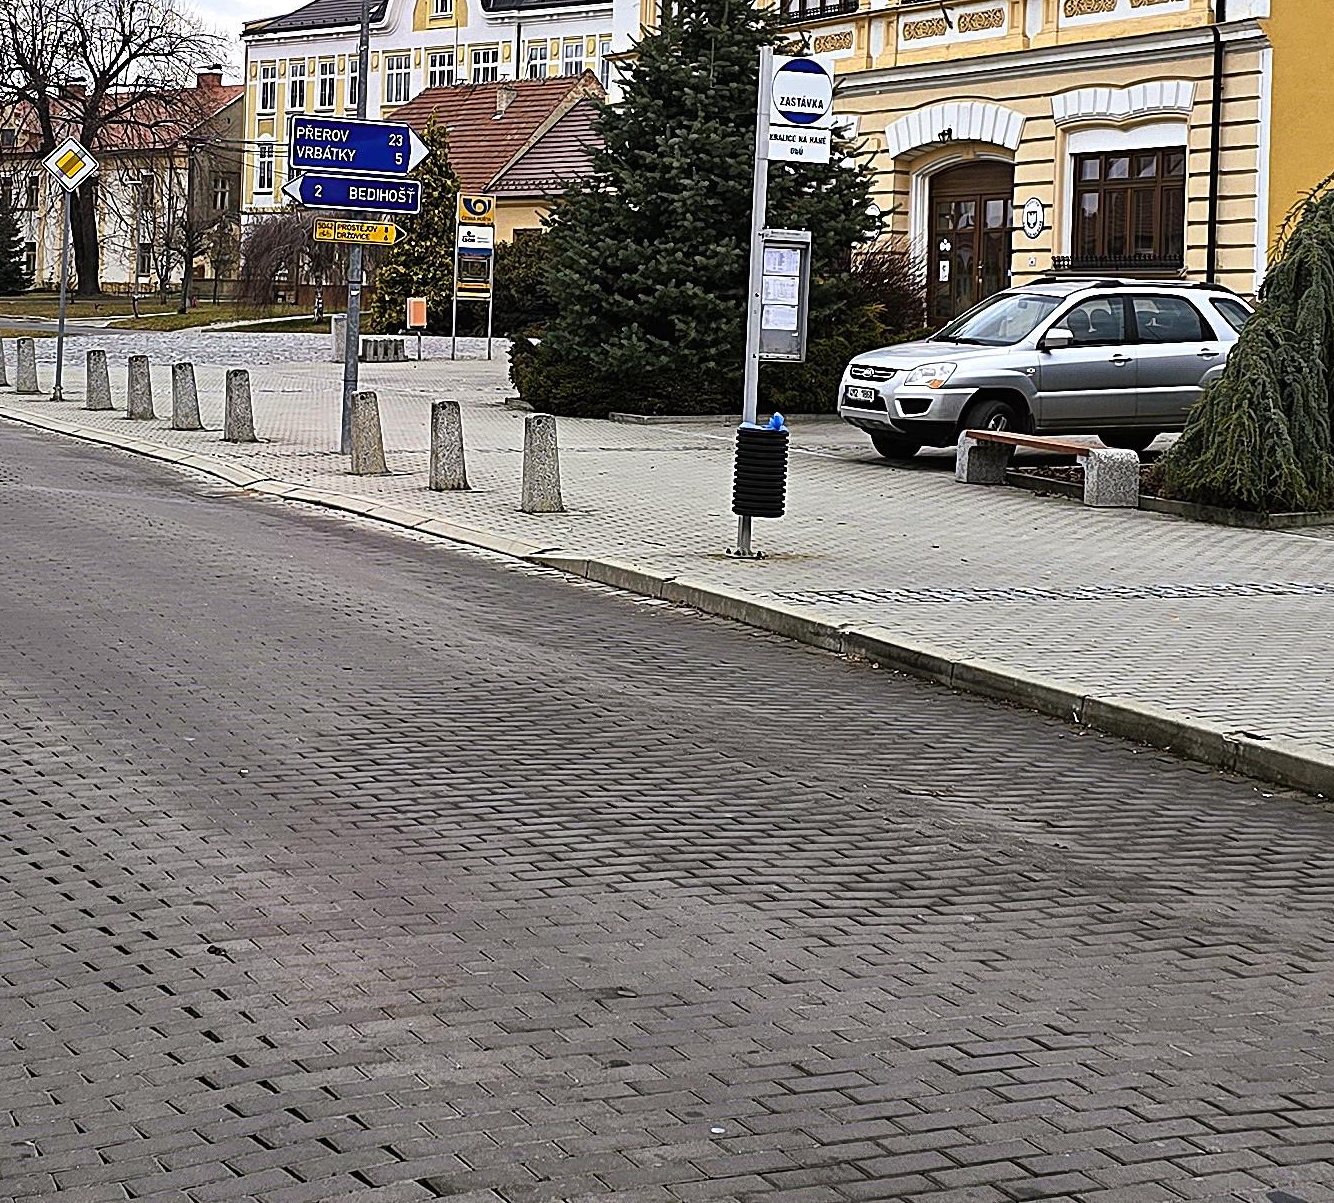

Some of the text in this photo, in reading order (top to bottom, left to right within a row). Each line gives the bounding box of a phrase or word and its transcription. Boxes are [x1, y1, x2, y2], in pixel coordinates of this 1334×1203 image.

[779, 96, 824, 110] ZASTÁVKA
[296, 124, 403, 146] PŘEROV 23
[296, 145, 403, 165] VRBÁTKY 5
[314, 184, 415, 204] 2 BEDIHOŠŤ
